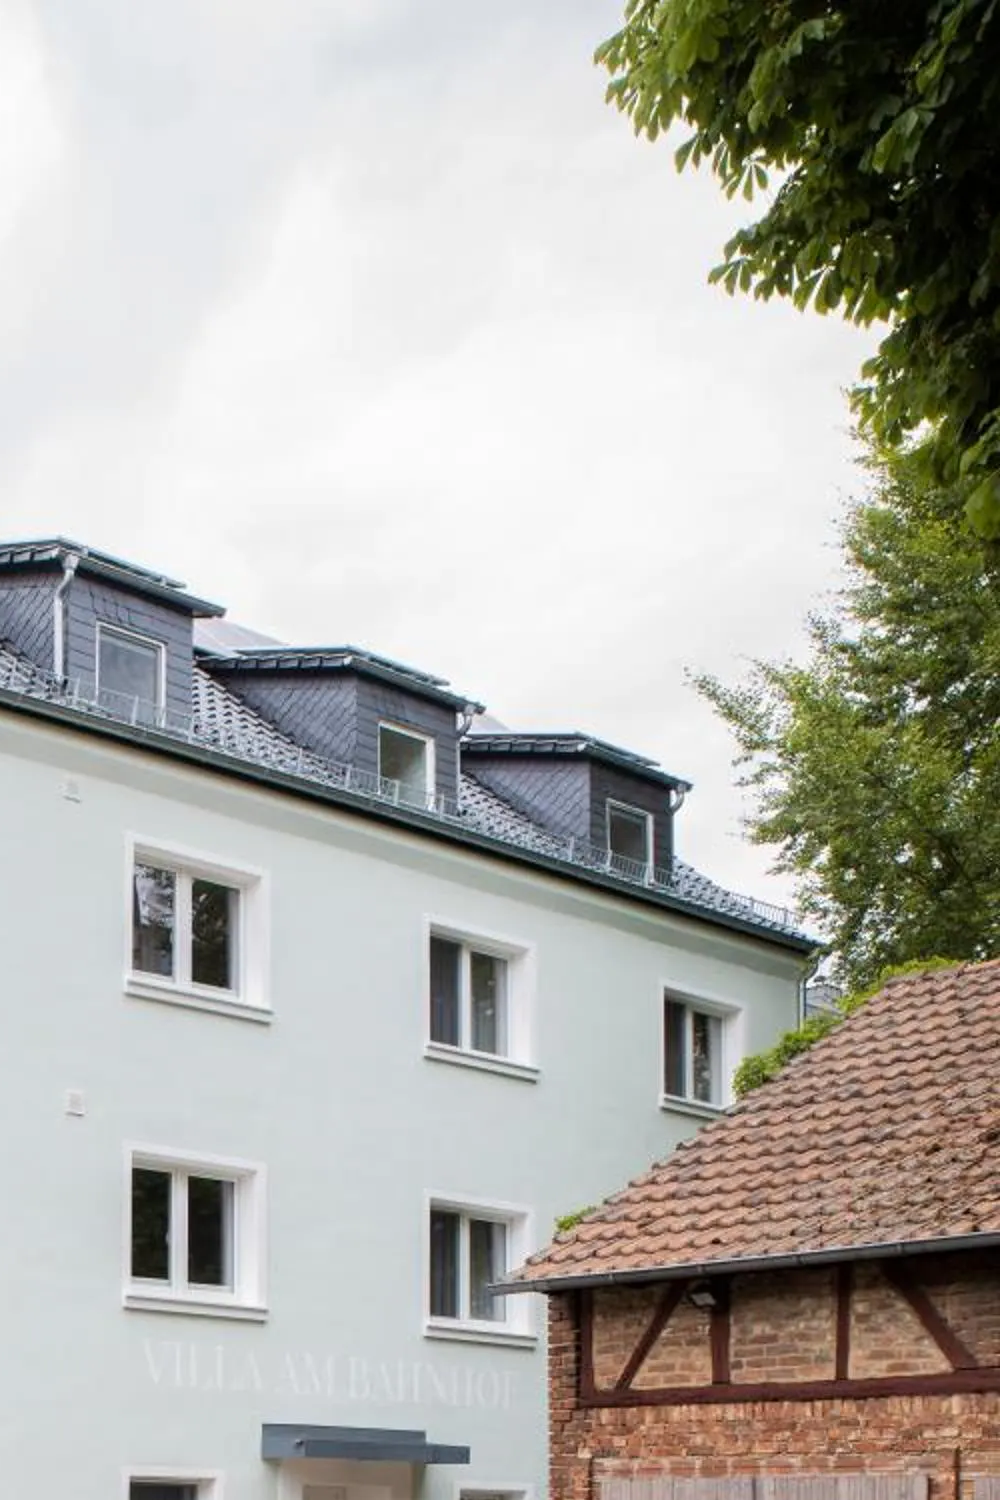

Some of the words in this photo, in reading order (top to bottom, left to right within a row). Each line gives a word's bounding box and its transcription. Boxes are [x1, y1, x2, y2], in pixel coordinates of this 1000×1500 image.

[142, 1338, 263, 1392] VILLA
[277, 1350, 336, 1397] AM
[347, 1355, 521, 1409] BAHNHOF
